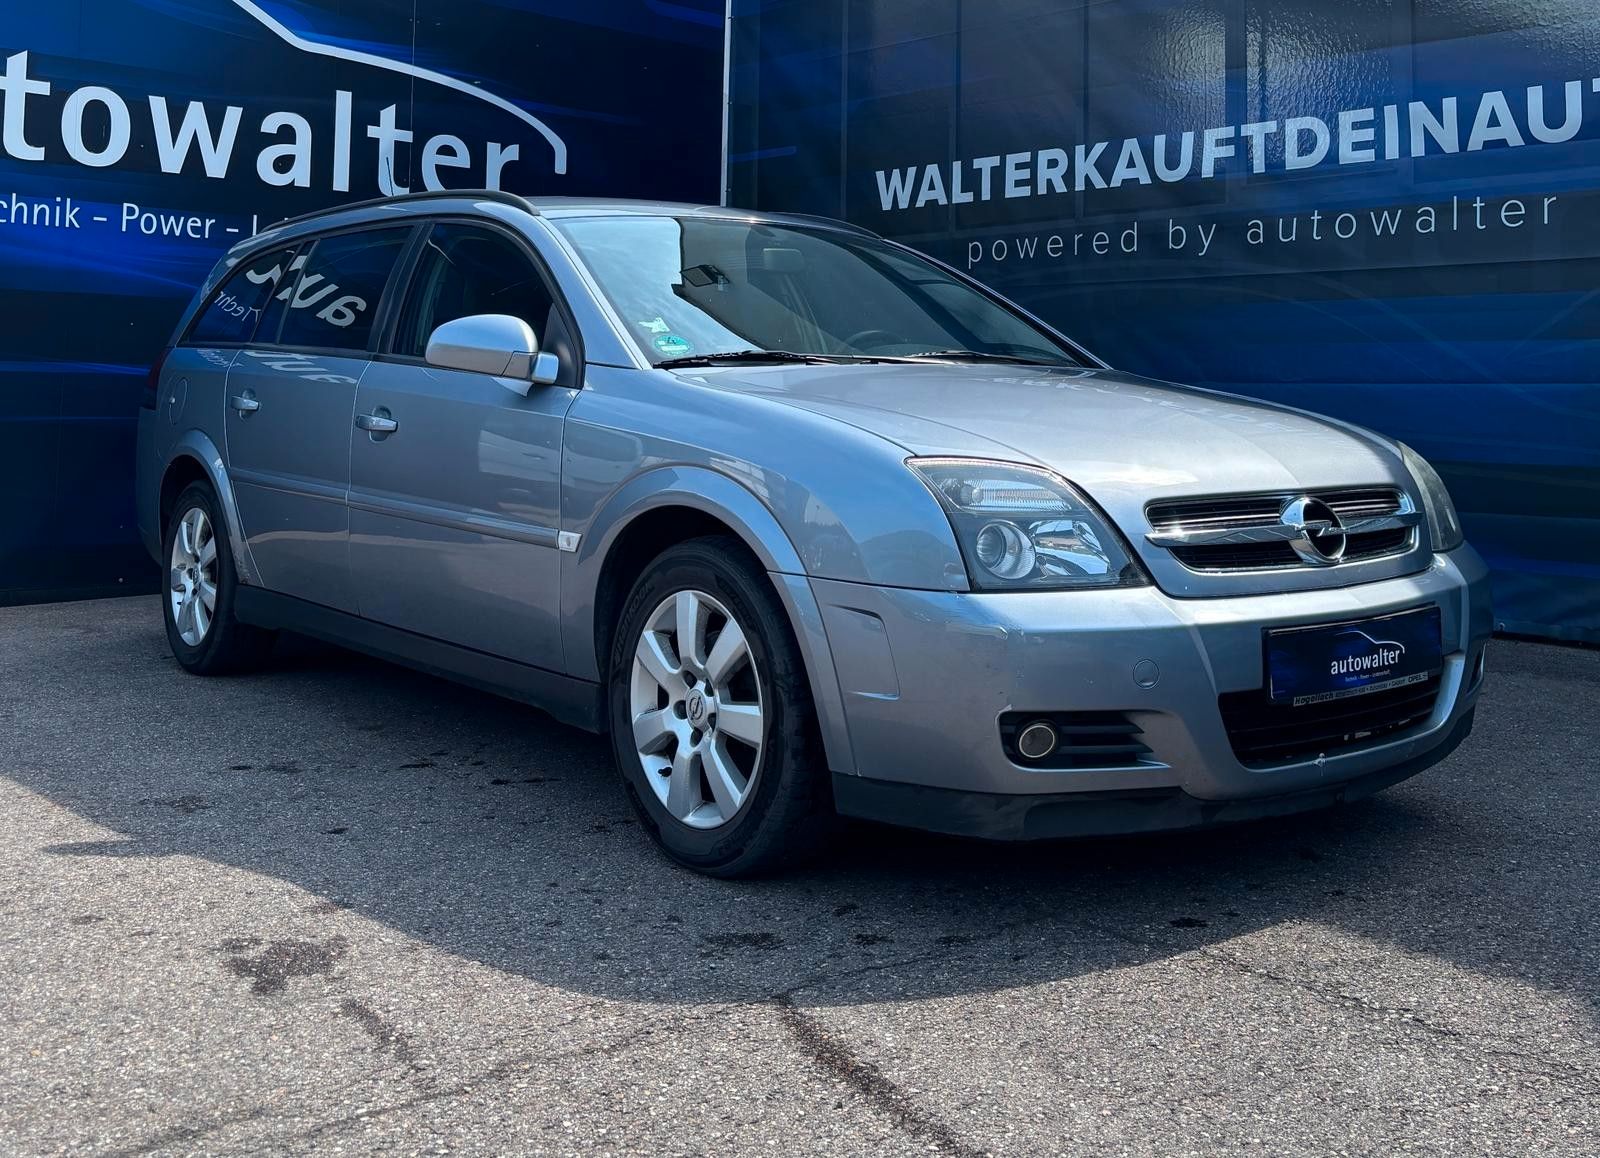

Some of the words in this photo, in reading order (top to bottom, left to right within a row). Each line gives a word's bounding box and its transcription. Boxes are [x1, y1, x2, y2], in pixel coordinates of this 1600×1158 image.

[876, 77, 1600, 211] WALTERKAUFTDEINAU
[121, 202, 216, 239] Power
[969, 219, 1138, 269] powered
[1169, 219, 1217, 256] by
[1247, 194, 1557, 245] autowalter
[1330, 648, 1400, 675] autowalter
